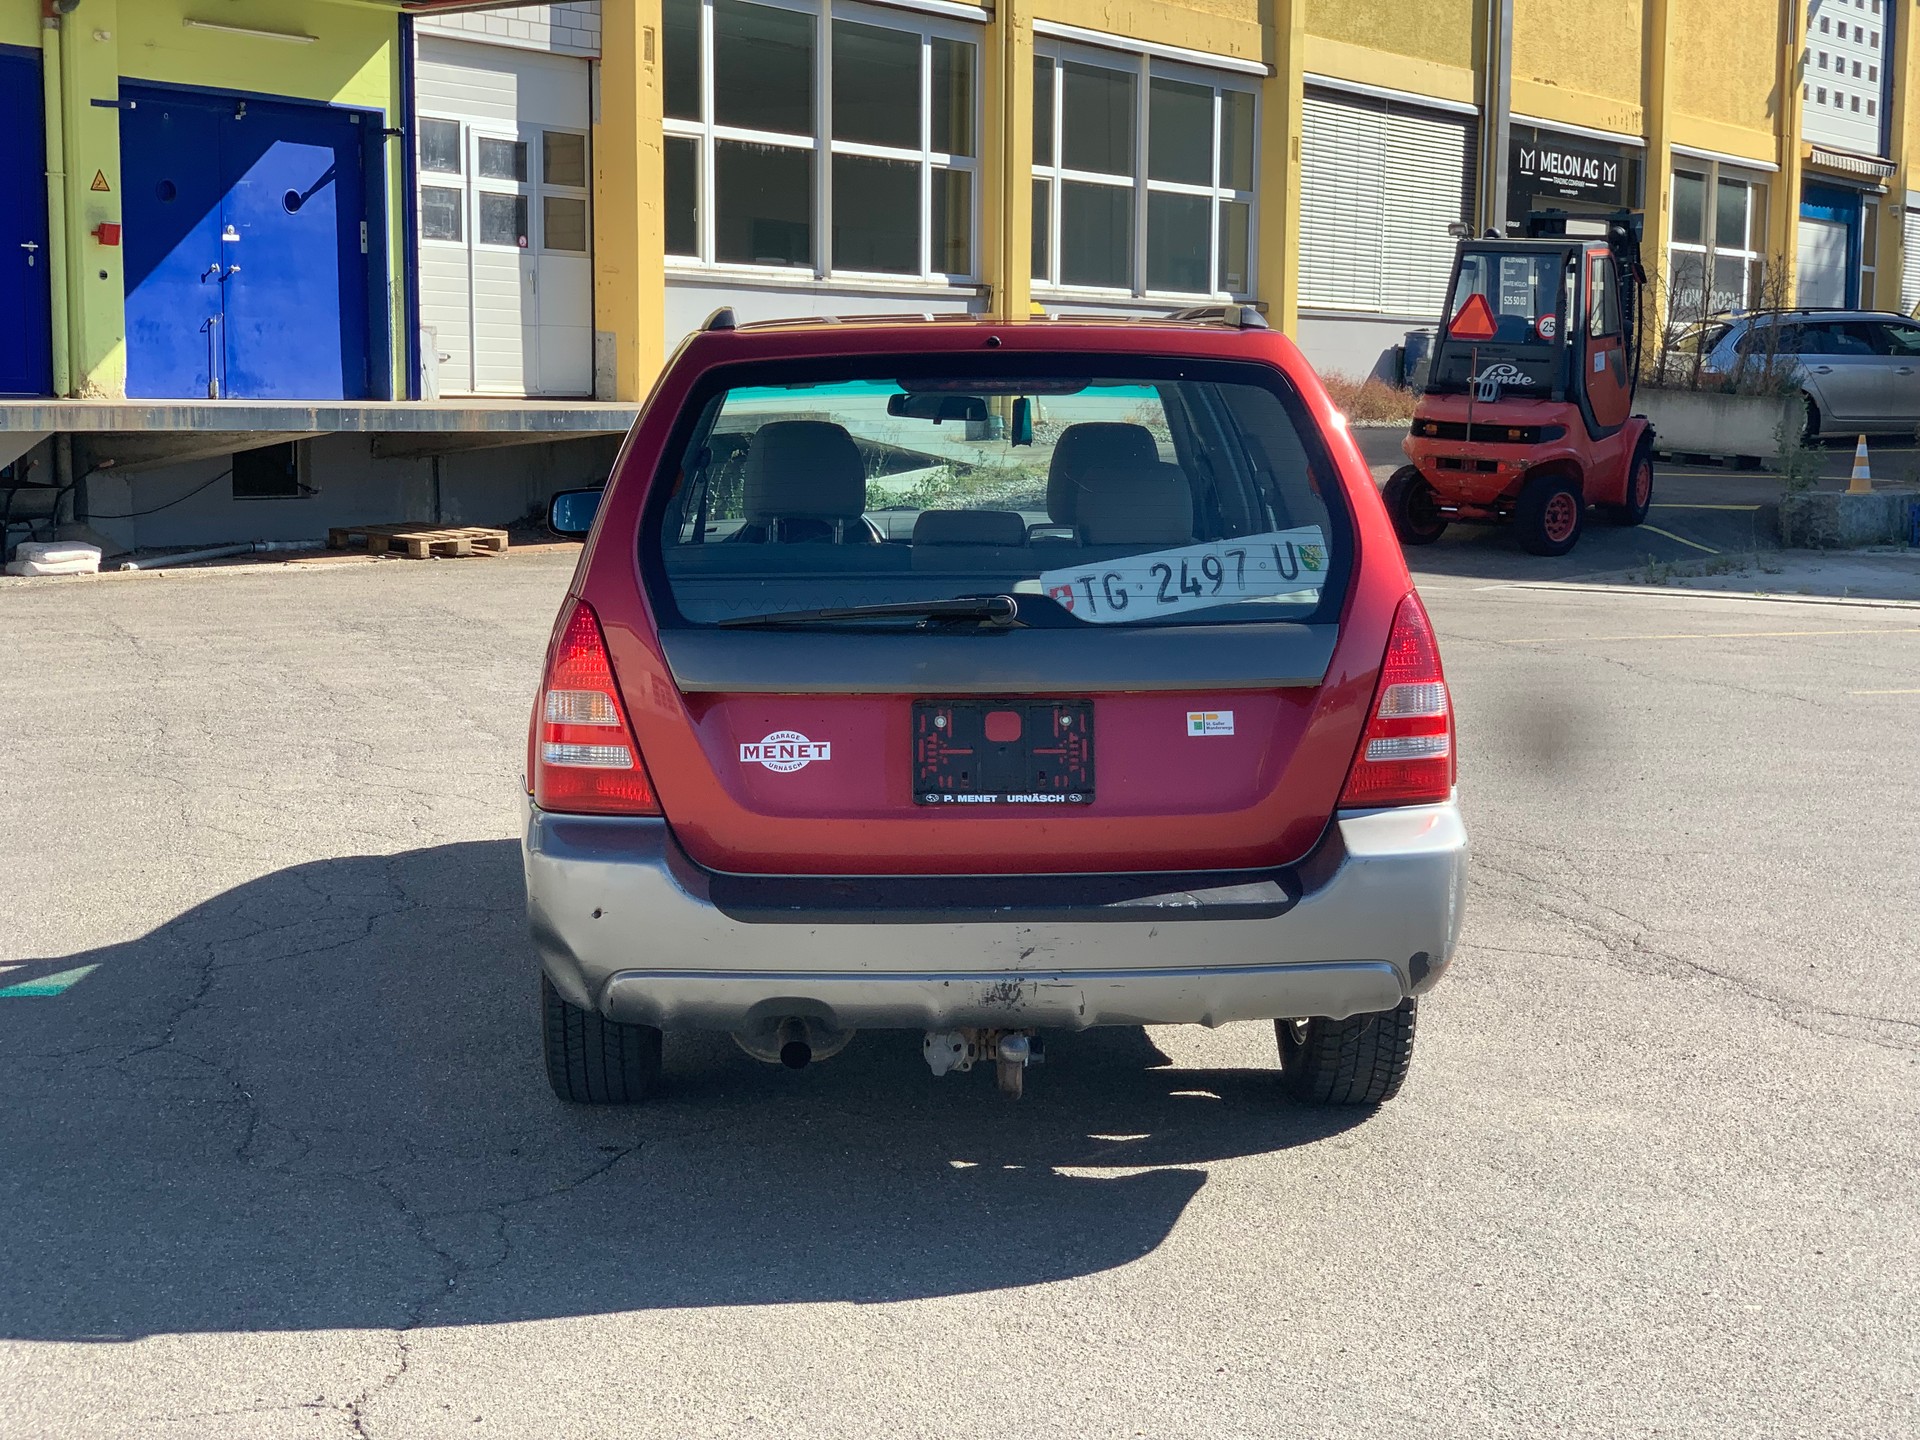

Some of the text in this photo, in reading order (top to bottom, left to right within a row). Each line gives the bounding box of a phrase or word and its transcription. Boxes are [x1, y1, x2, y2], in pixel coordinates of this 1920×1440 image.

[1540, 151, 1599, 179] MELON AG
[1542, 321, 1556, 333] 25
[1466, 363, 1536, 386] Linde
[1076, 541, 1300, 616] TG 2497 U
[770, 733, 800, 741] GARAGE
[743, 744, 827, 759] MENET
[943, 793, 1065, 803] P. MENET URNÄSCH
